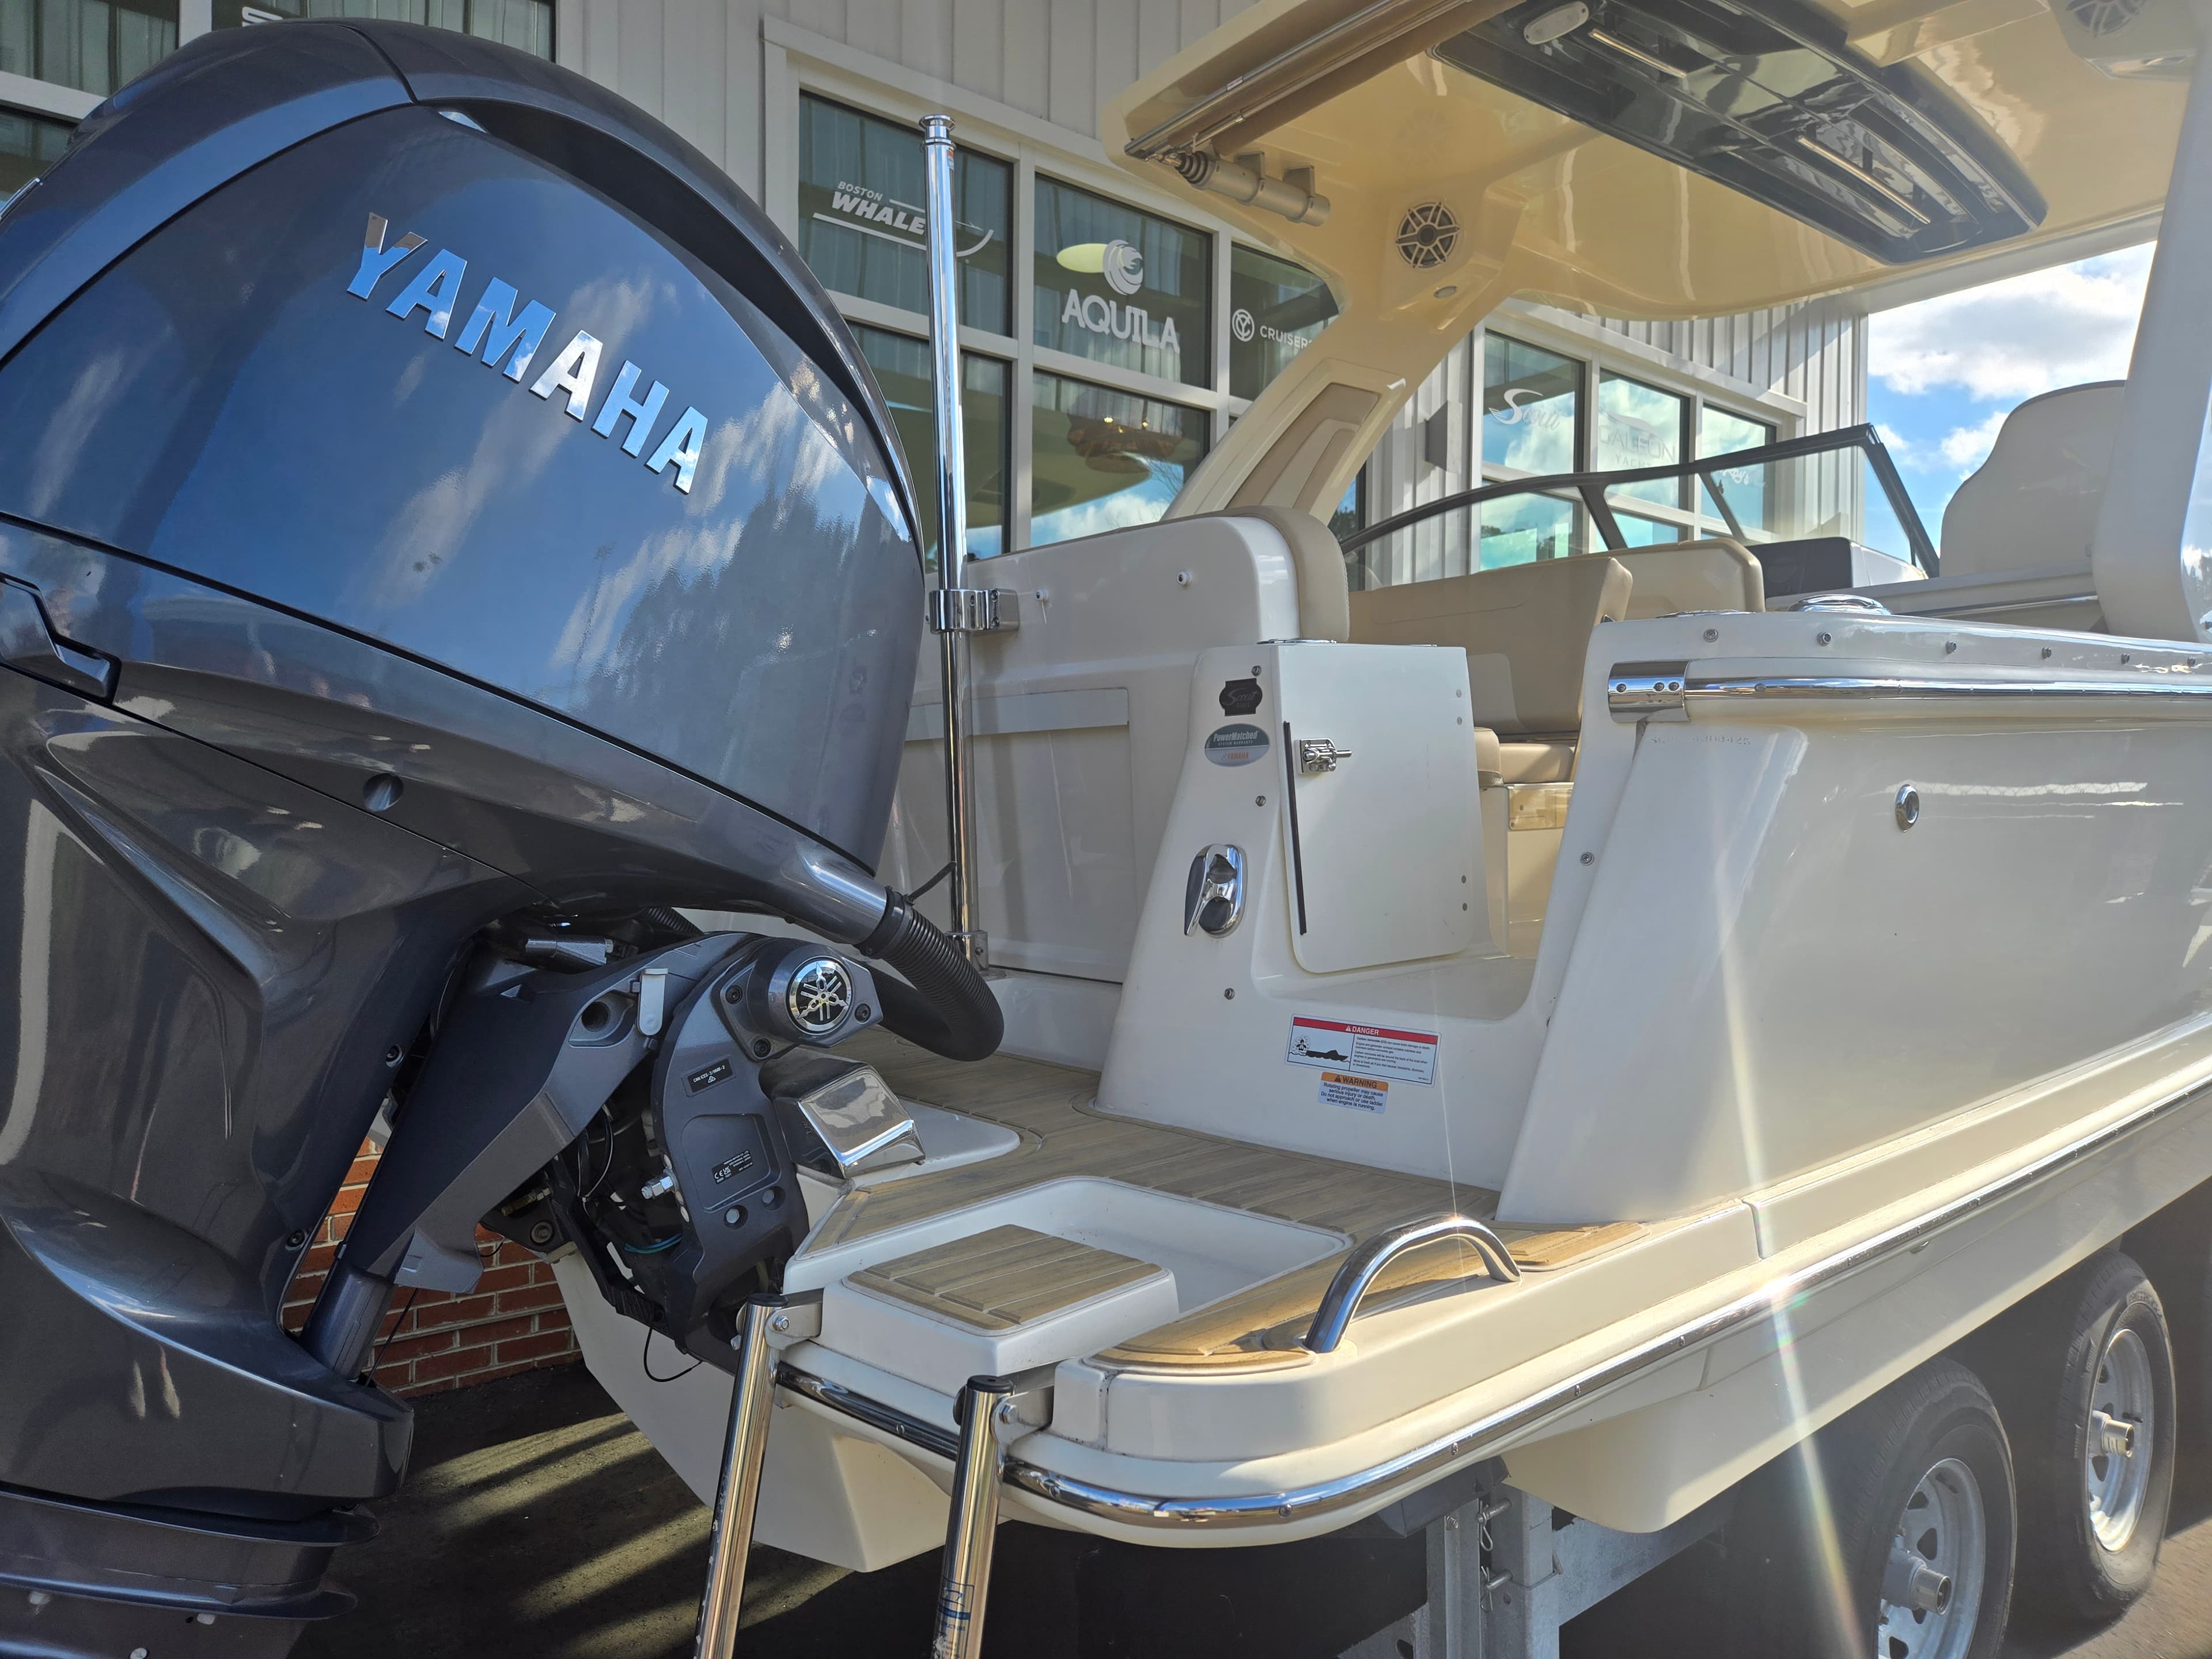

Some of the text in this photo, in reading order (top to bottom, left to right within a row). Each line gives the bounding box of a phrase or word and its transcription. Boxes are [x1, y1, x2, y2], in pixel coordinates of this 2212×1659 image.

[838, 181, 883, 201] BOSTON
[832, 192, 926, 236] WHALE
[1062, 289, 1180, 354] AQUILA
[1260, 325, 1313, 349] CRUISER
[347, 212, 709, 494] YAMAHA
[1488, 388, 1562, 430] Scout
[1599, 425, 1675, 463] GALEON
[1222, 687, 1259, 706] Scout
[1213, 730, 1258, 742] PowerMatched
[1226, 752, 1249, 760] YAMAHA
[1352, 1026, 1379, 1036] DANGER
[1343, 1076, 1377, 1089] WARNING
